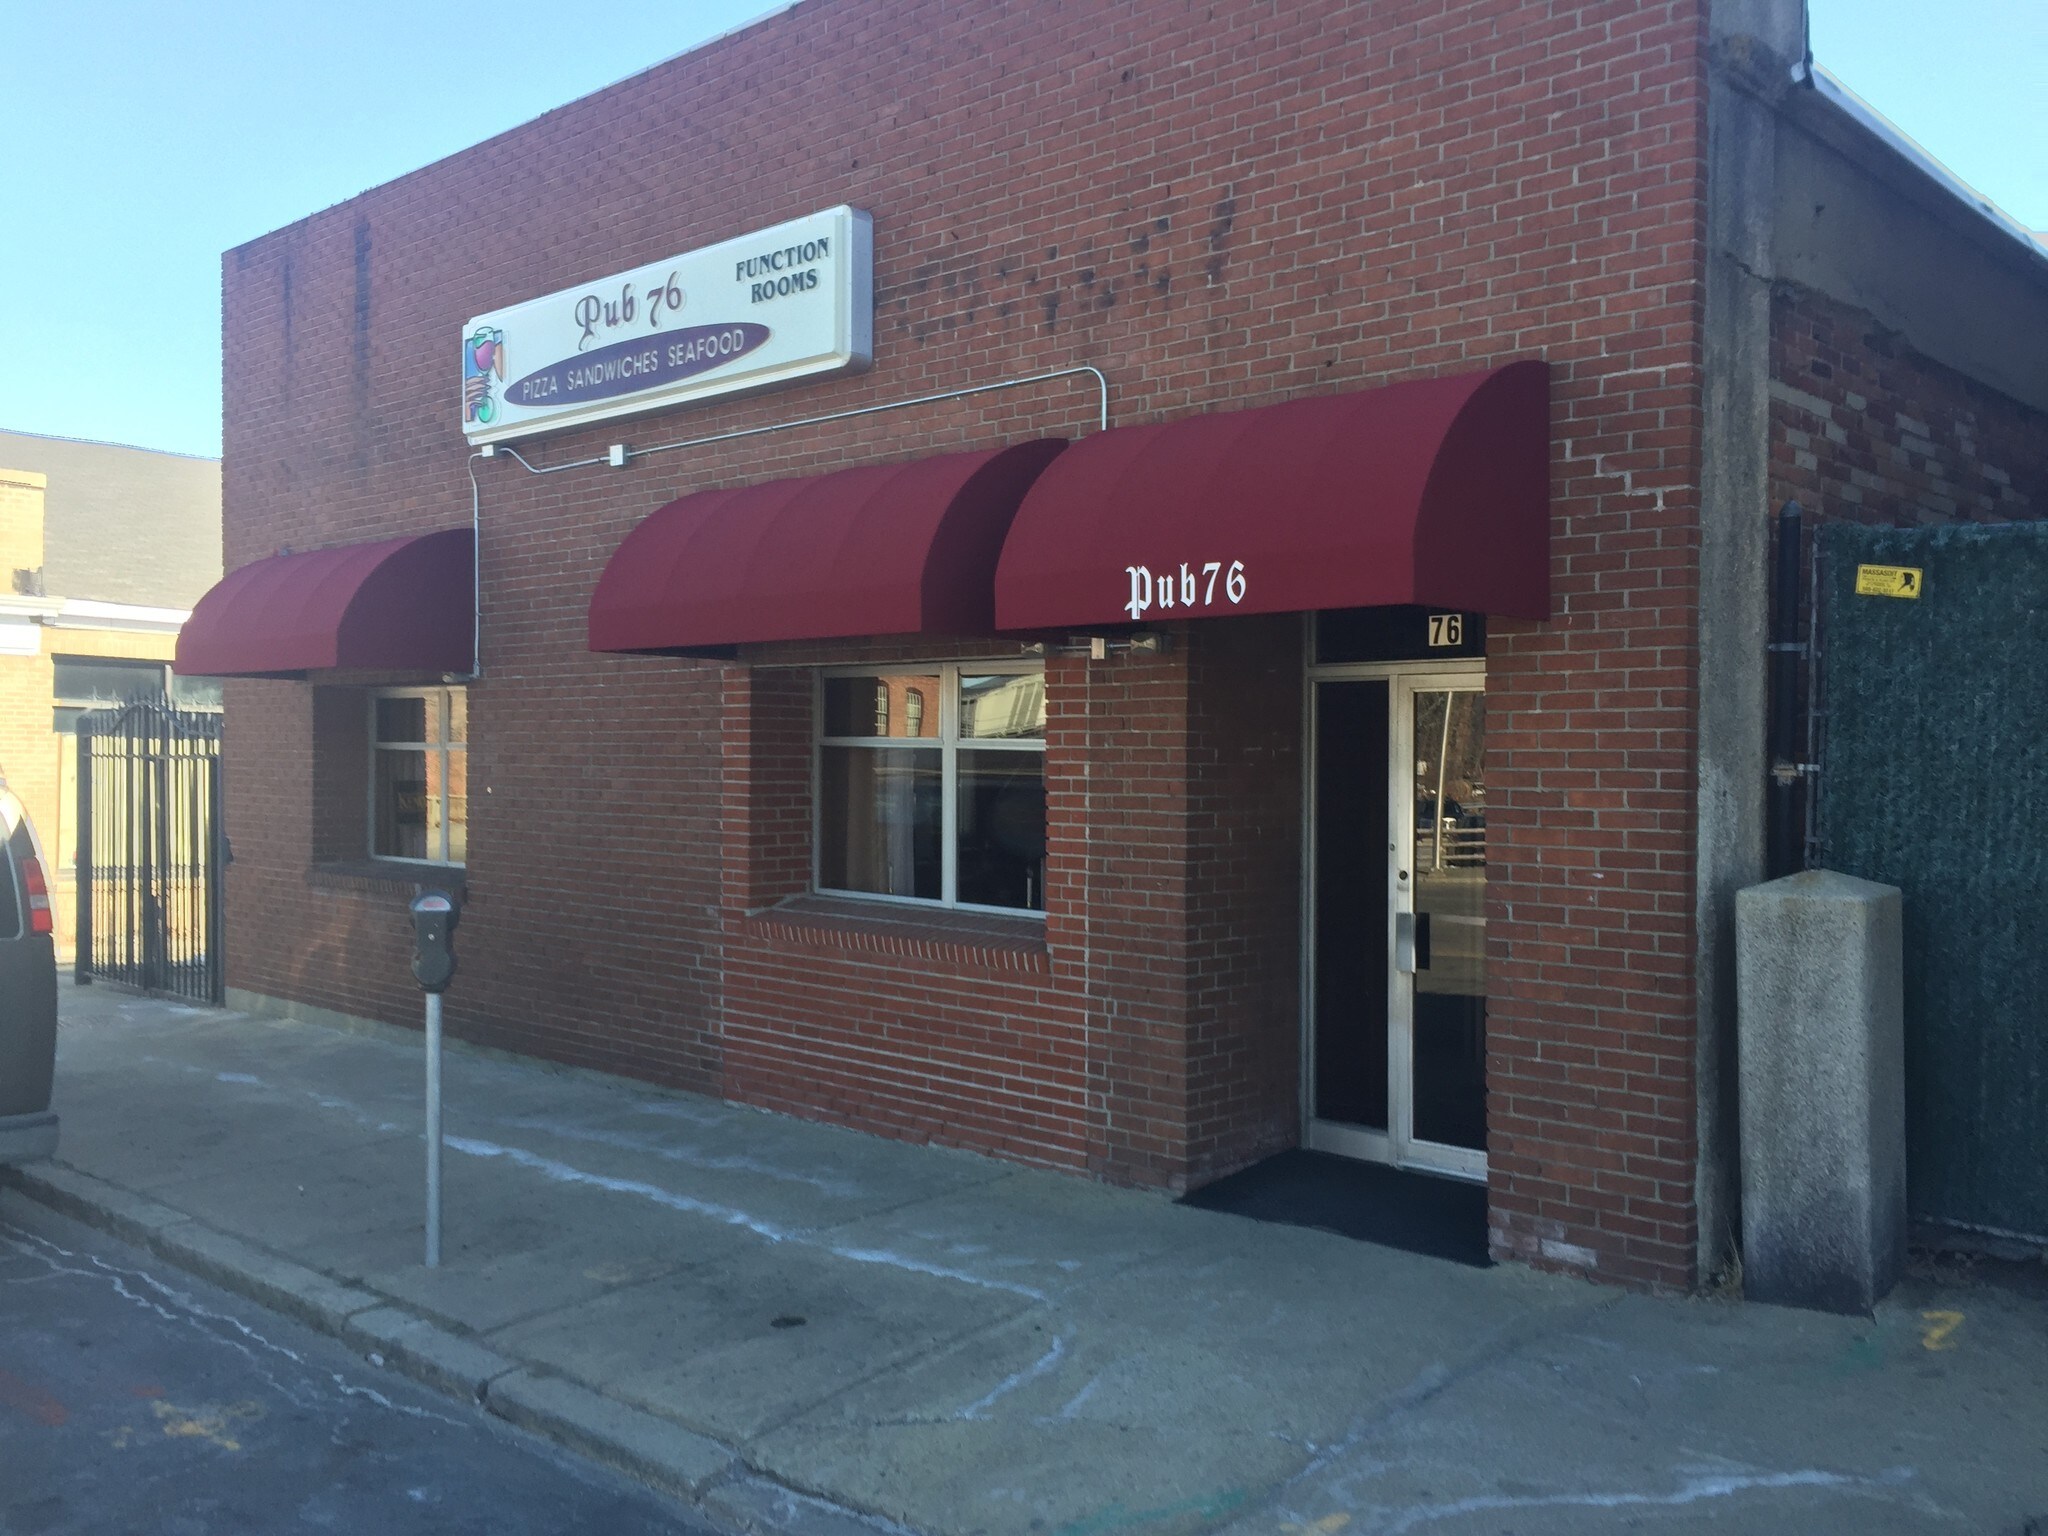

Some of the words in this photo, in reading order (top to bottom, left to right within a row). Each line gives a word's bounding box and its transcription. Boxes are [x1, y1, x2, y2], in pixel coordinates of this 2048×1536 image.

[736, 237, 829, 281] FUNCTION
[751, 268, 818, 304] ROOMS
[575, 283, 636, 351] Pub
[646, 270, 683, 328] 76
[522, 376, 558, 401] PIZZA
[566, 350, 659, 391] SANDWICHES
[667, 329, 745, 367] SEAFOOD
[1430, 616, 1460, 645] 76
